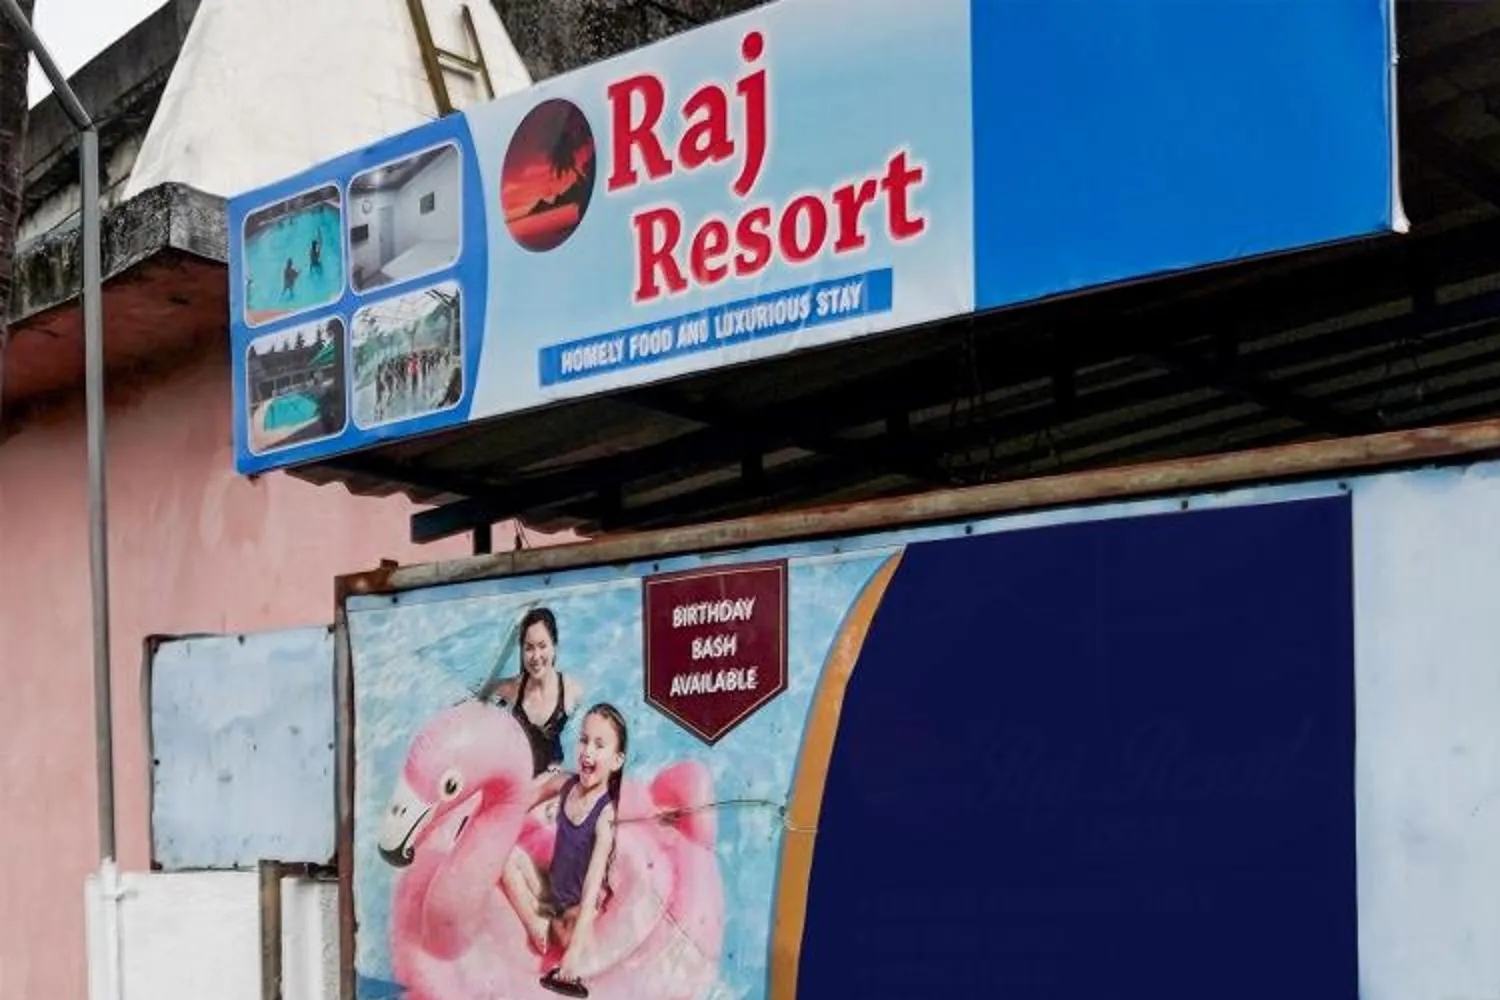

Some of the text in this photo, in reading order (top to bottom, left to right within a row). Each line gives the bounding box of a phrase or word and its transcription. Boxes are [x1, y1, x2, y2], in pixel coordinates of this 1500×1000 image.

[607, 31, 767, 195] Raj
[634, 152, 925, 301] Resort
[561, 282, 863, 374] HOMELY FOOD AND LUXURIOUS STAY
[673, 597, 756, 628] BIRTHDAY
[691, 633, 737, 659] BASH
[670, 667, 758, 696] AVAILABLE
